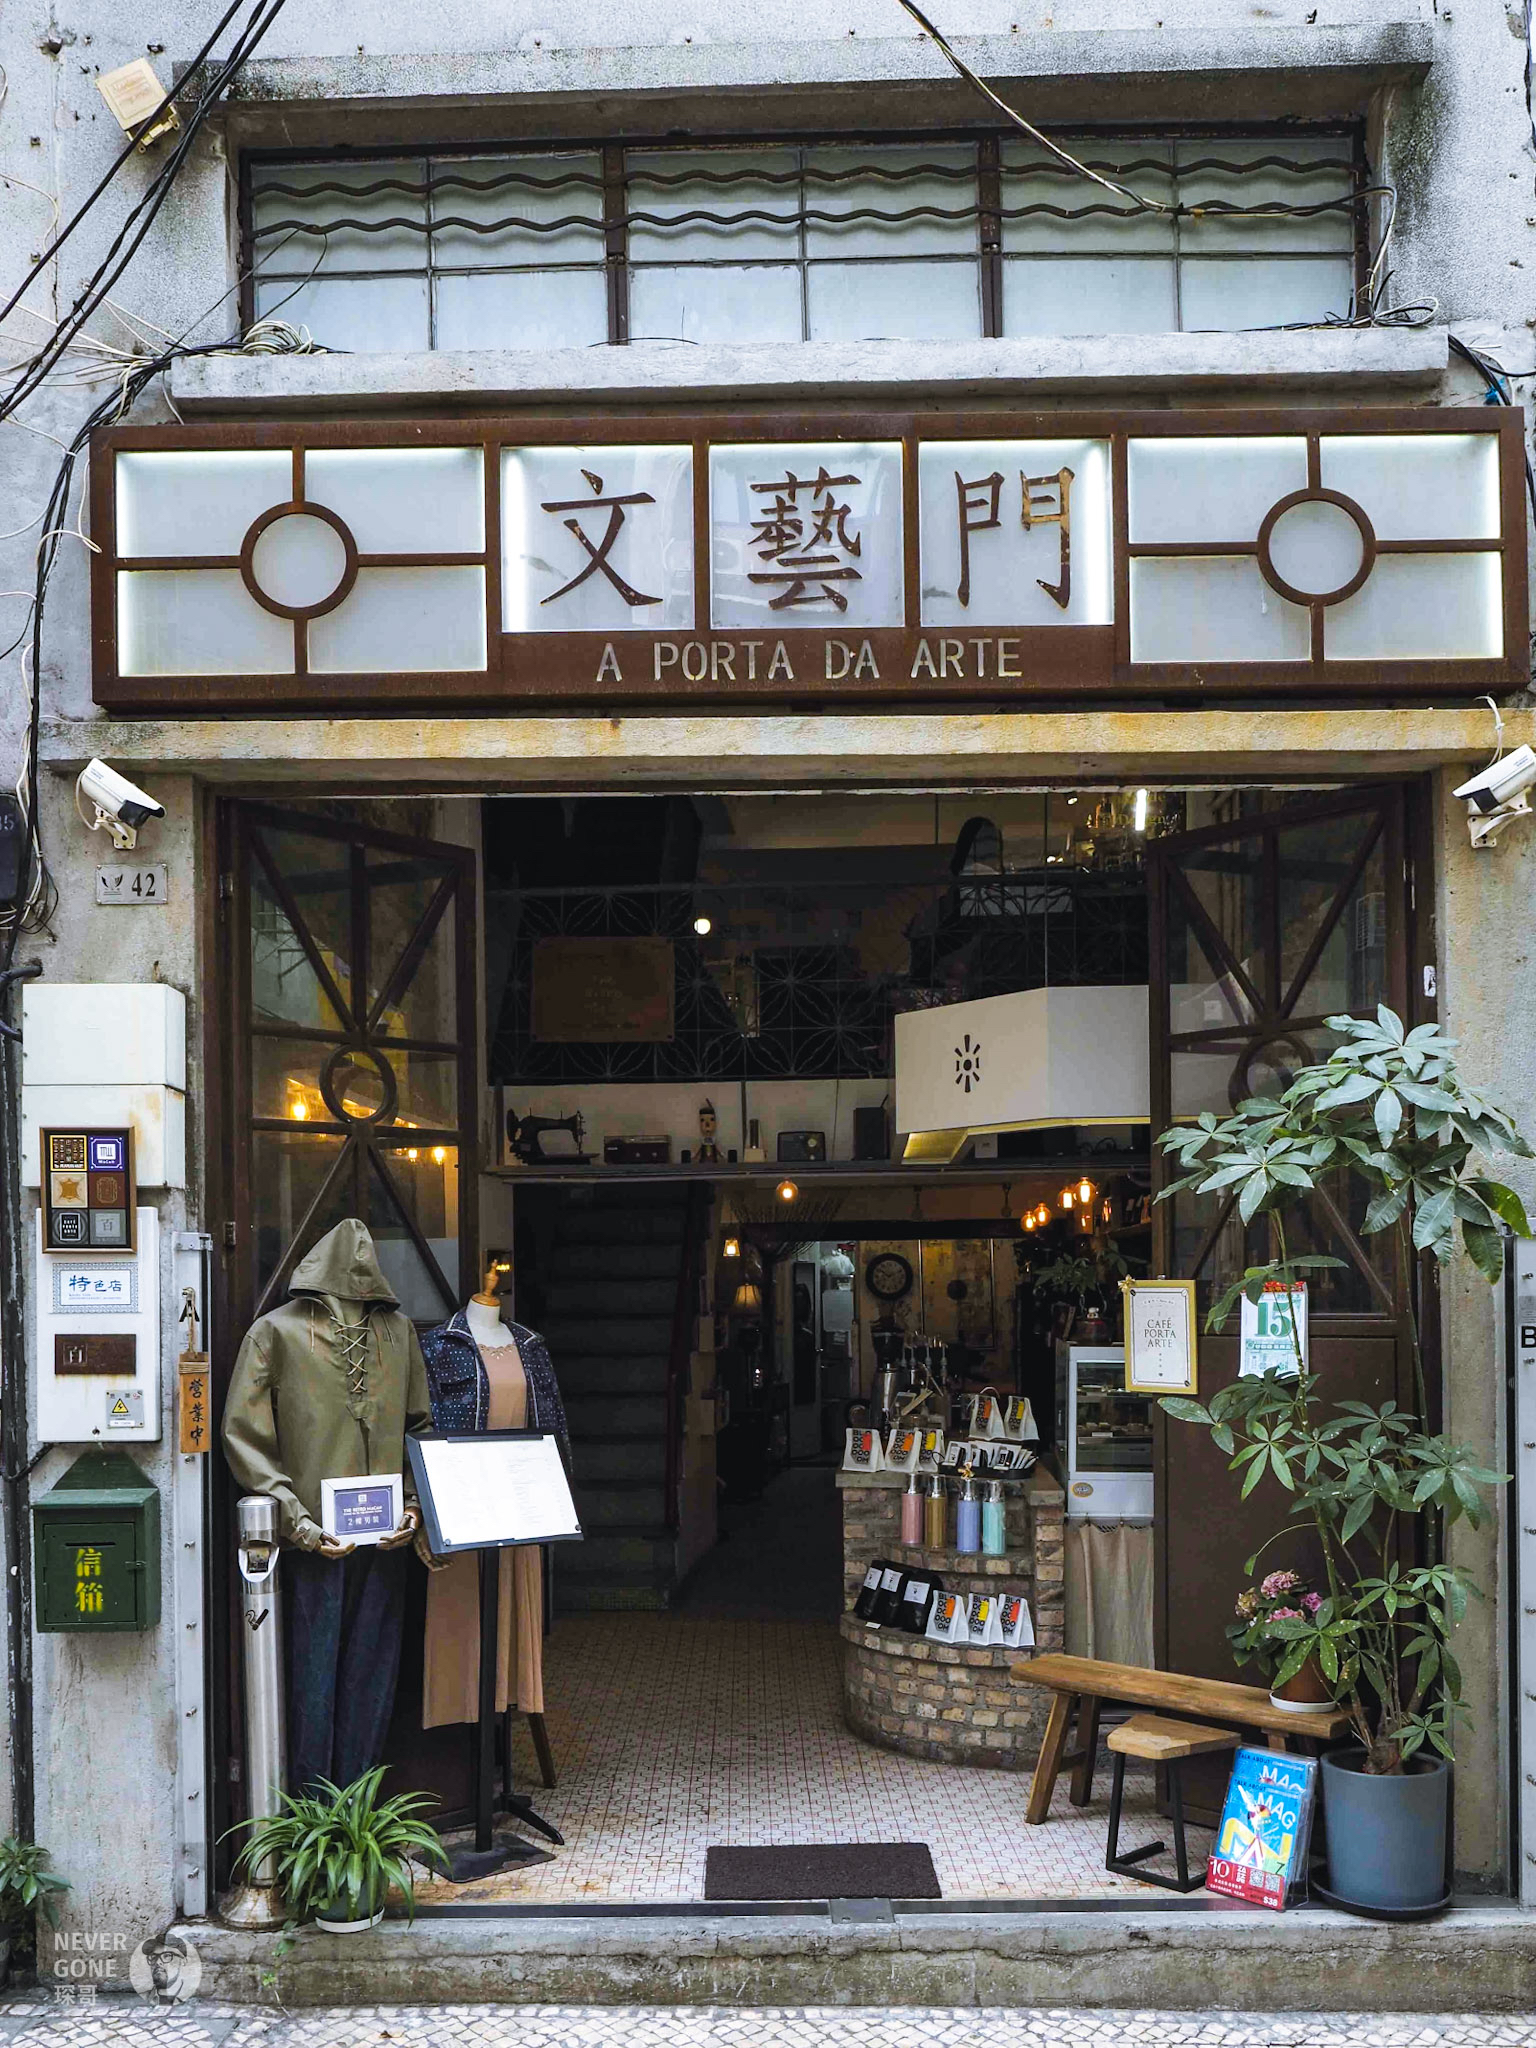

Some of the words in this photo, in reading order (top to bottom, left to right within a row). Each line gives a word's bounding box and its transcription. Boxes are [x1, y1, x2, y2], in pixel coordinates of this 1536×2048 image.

[540, 466, 1076, 612] 文藝門
[596, 643, 621, 682] A
[653, 640, 794, 681] PORTA
[825, 640, 880, 680] DA
[910, 637, 1023, 679] ARTE
[131, 873, 156, 897] 42
[68, 1274, 122, 1293] 特色店
[1147, 1317, 1172, 1328] CAFÉ
[1255, 1302, 1292, 1337] 15
[1144, 1328, 1177, 1338] PORTA
[1147, 1338, 1173, 1348] ARTE
[189, 1378, 204, 1447] 營業中
[75, 1547, 103, 1612] 信箱
[1238, 1752, 1251, 1760] TALK
[1252, 1756, 1270, 1764] ABOUT
[1249, 1783, 1266, 1791] ABOUT
[1210, 1859, 1230, 1878] 10
